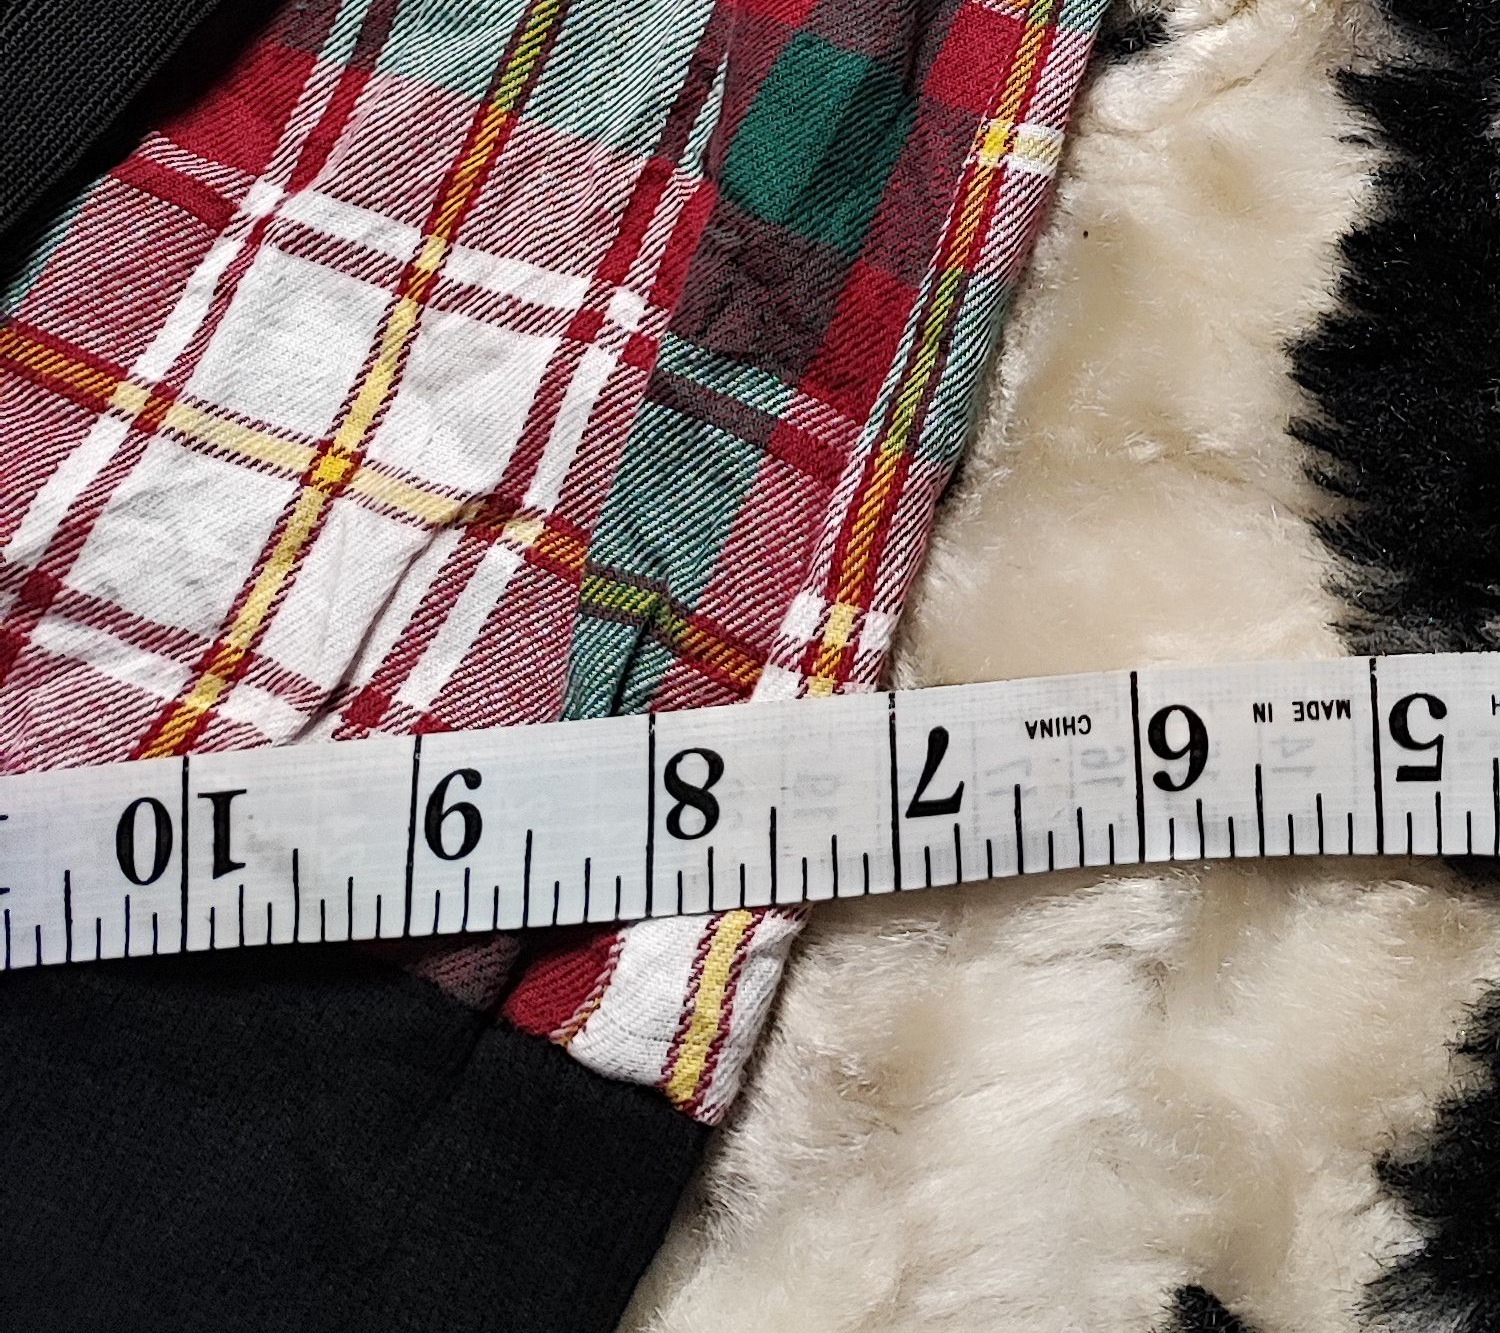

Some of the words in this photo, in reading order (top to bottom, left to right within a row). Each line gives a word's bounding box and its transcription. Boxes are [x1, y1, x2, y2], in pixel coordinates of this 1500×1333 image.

[1024, 713, 1092, 741] CHINA
[1147, 703, 1210, 793] 6
[1251, 699, 1274, 725] IN
[1292, 698, 1352, 723] MADE
[1388, 692, 1448, 782] 5
[424, 767, 484, 861] 9
[663, 747, 725, 841] 8
[905, 725, 965, 819] 7
